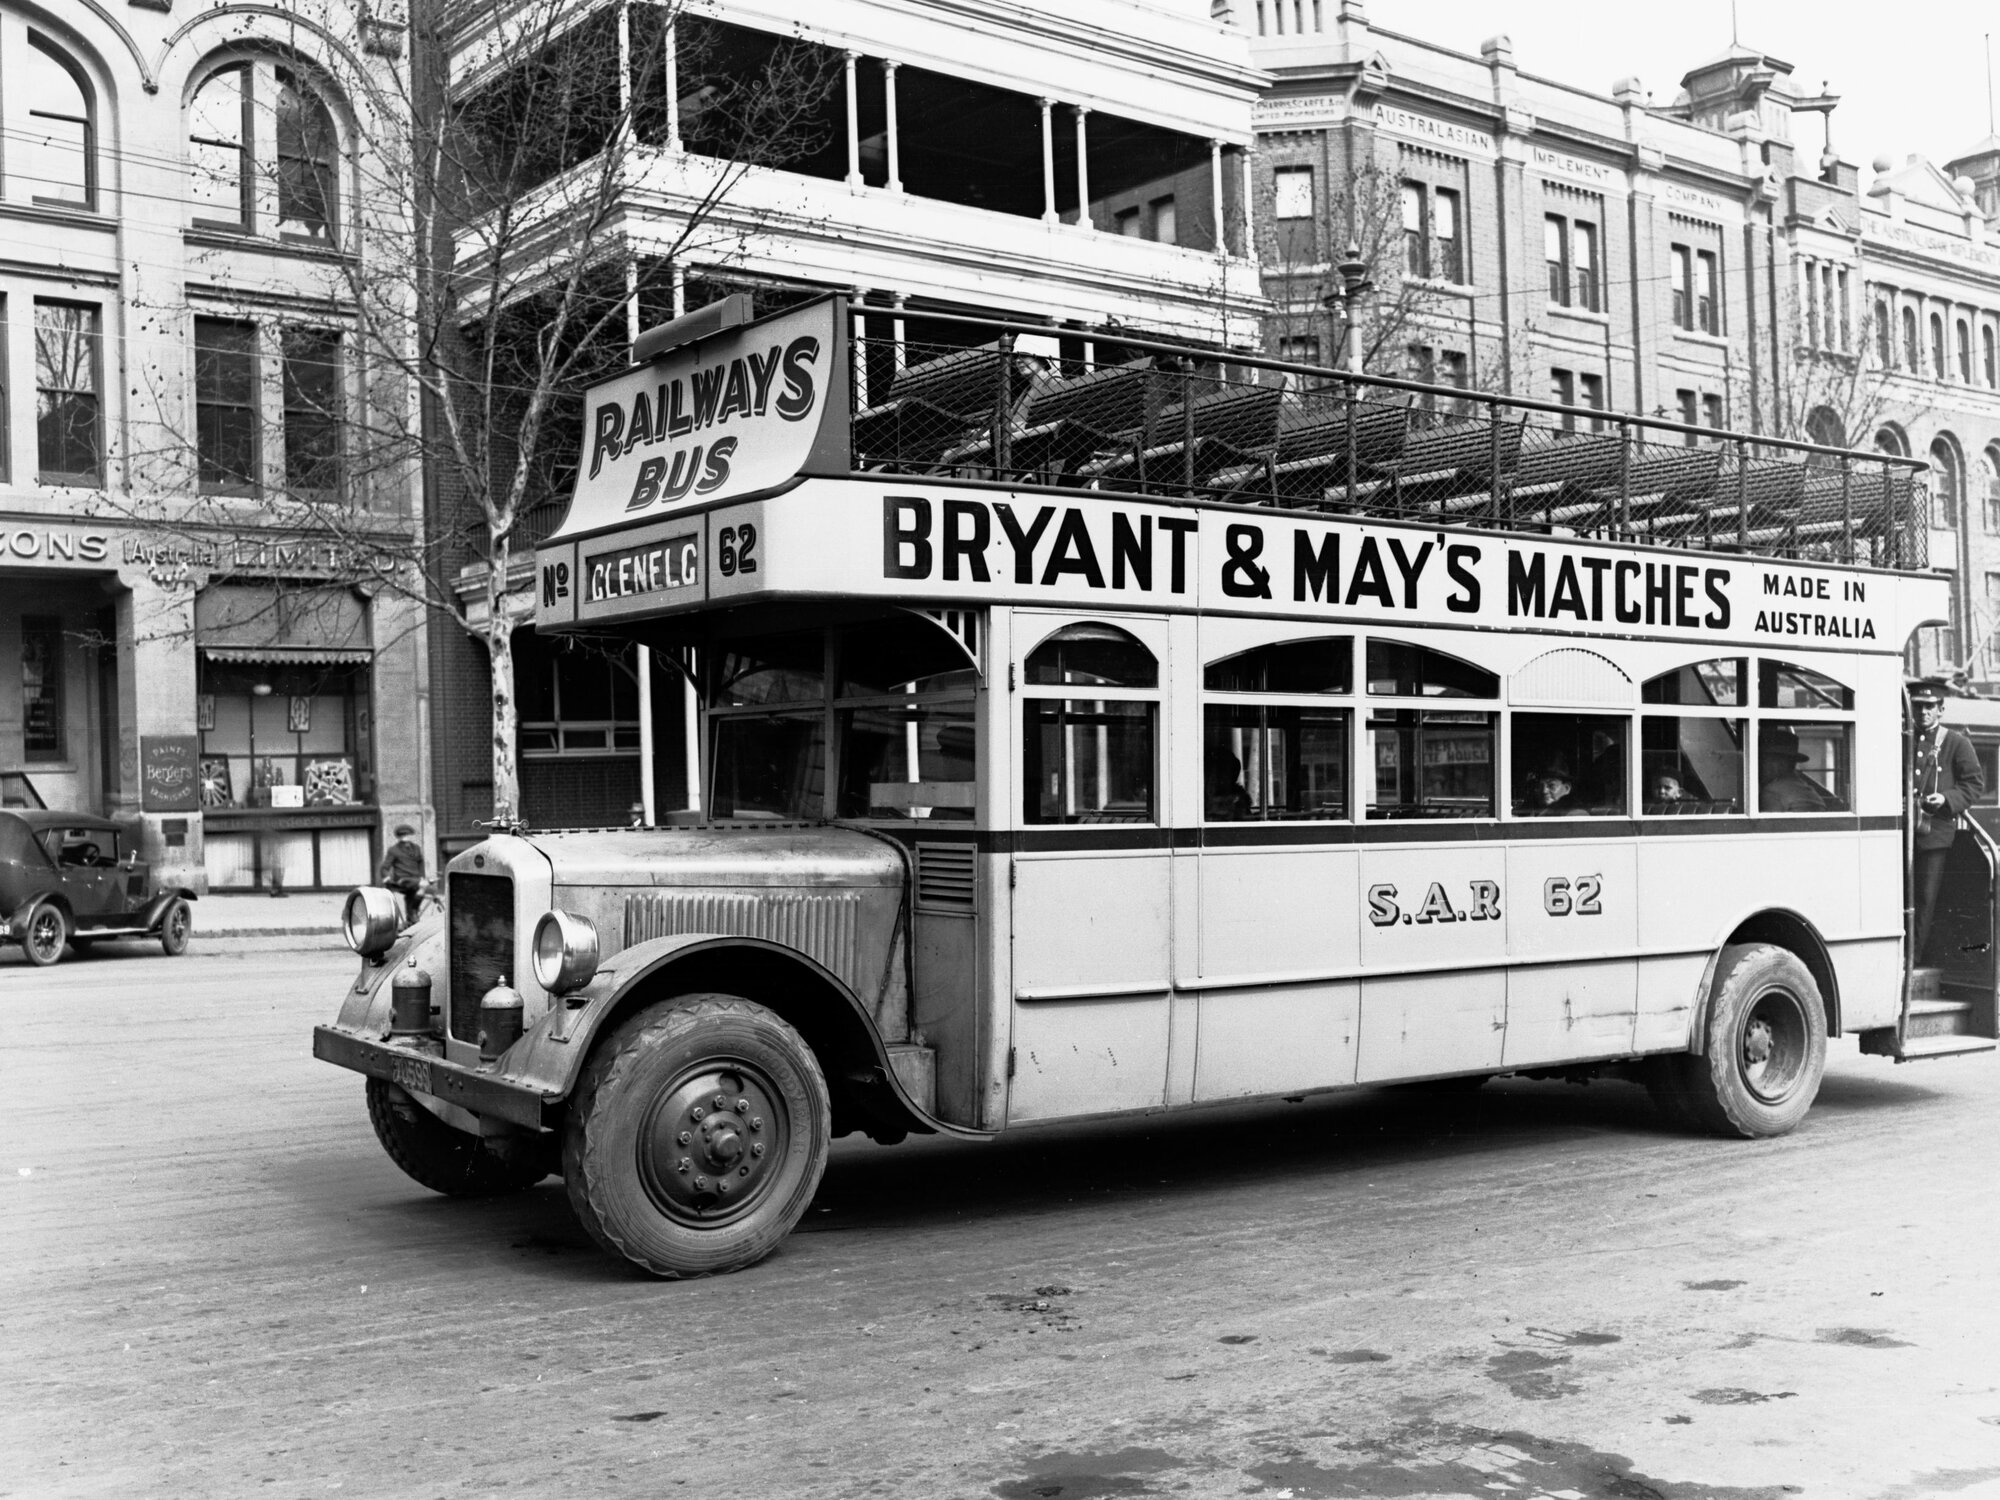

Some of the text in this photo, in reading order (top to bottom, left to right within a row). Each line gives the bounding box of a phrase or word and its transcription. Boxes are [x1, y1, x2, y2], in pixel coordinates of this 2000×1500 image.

[1375, 105, 1723, 210] AUSTRALASIAN IMPLEMENT COMPANY
[588, 335, 820, 480] RAILWAYS
[625, 436, 738, 513] BUS
[0, 529, 107, 562] ONS
[592, 543, 697, 601] GLENELG
[718, 522, 757, 577] 62
[883, 495, 1731, 630] BRYANT & MAY'S MATCHES
[1763, 573, 1866, 603] MADE IN
[1754, 610, 1876, 640] AUSTRALIA
[1544, 875, 1601, 917] 62
